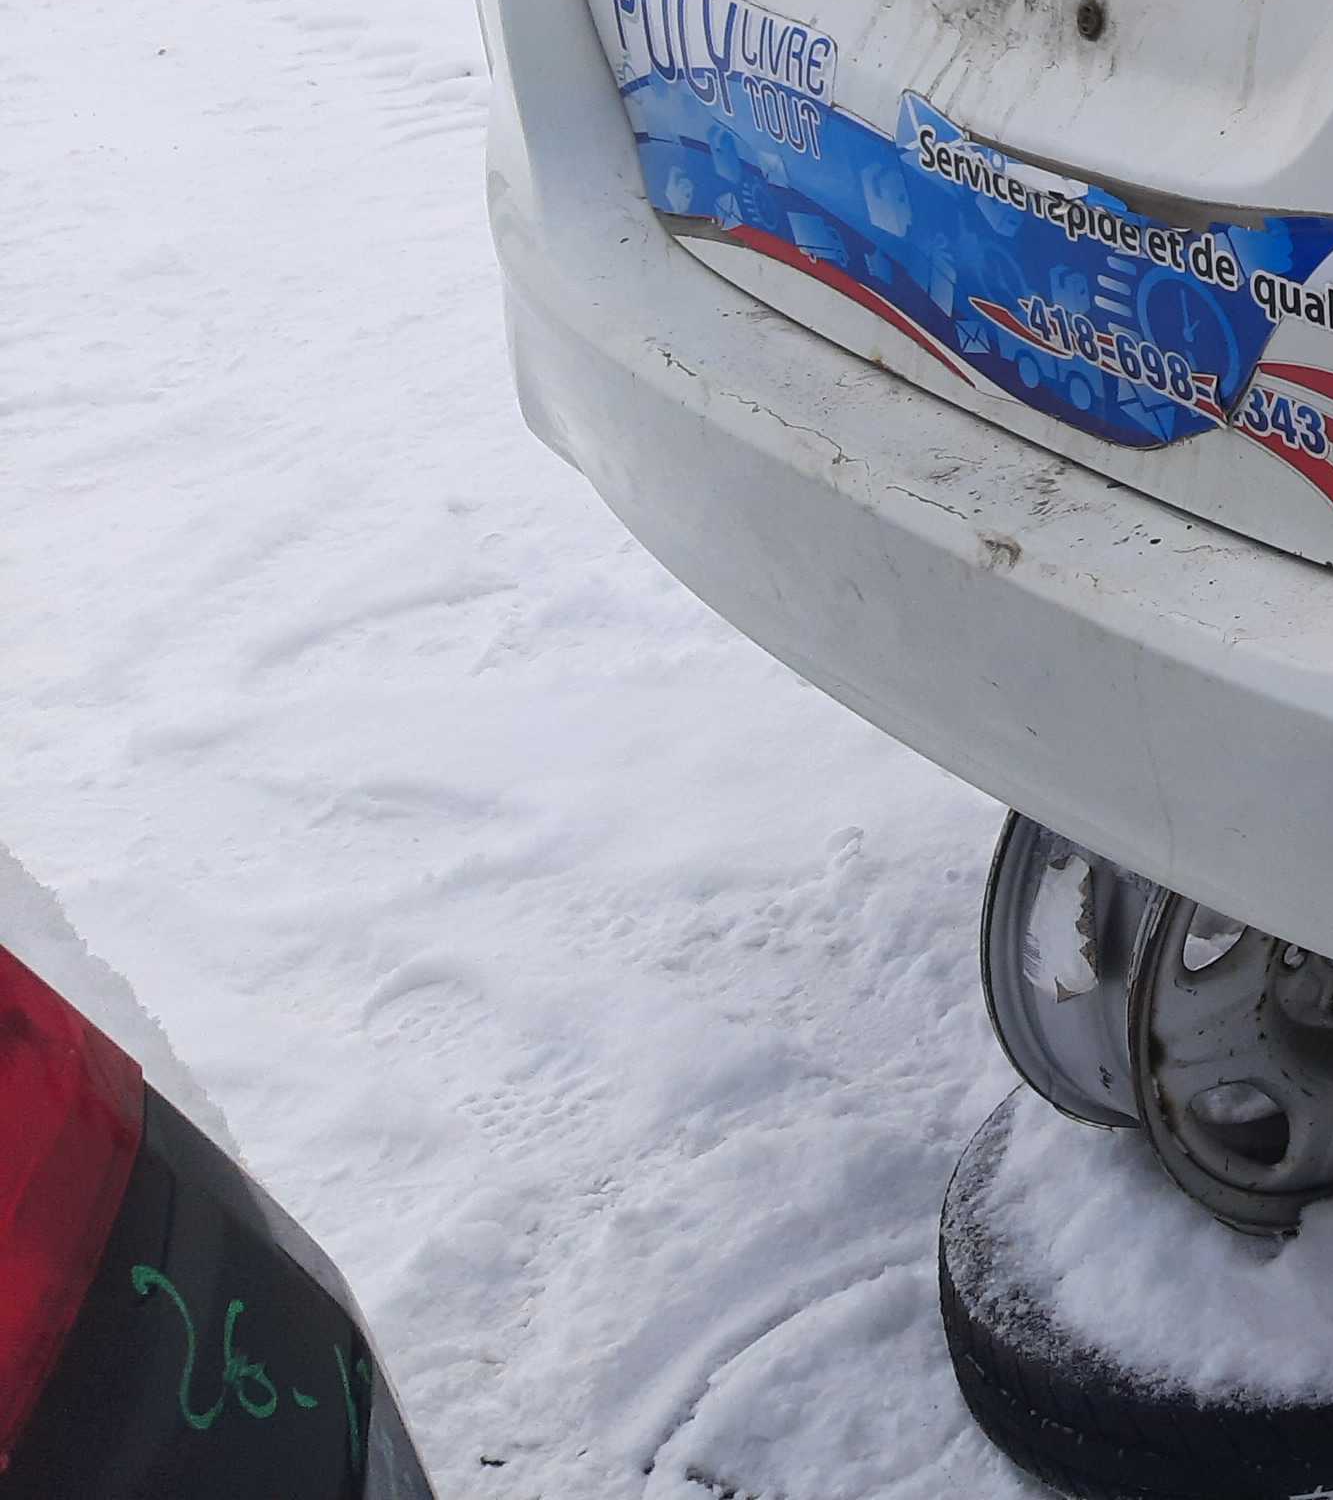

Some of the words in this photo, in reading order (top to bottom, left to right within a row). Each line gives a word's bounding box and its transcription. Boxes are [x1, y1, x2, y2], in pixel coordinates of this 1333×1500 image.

[741, 7, 833, 98] LIVRE
[743, 74, 822, 161] TOUT
[917, 128, 1026, 205] Service
[1145, 227, 1185, 271] et
[1191, 235, 1238, 290] de
[1025, 296, 1330, 457] 418-698-343
